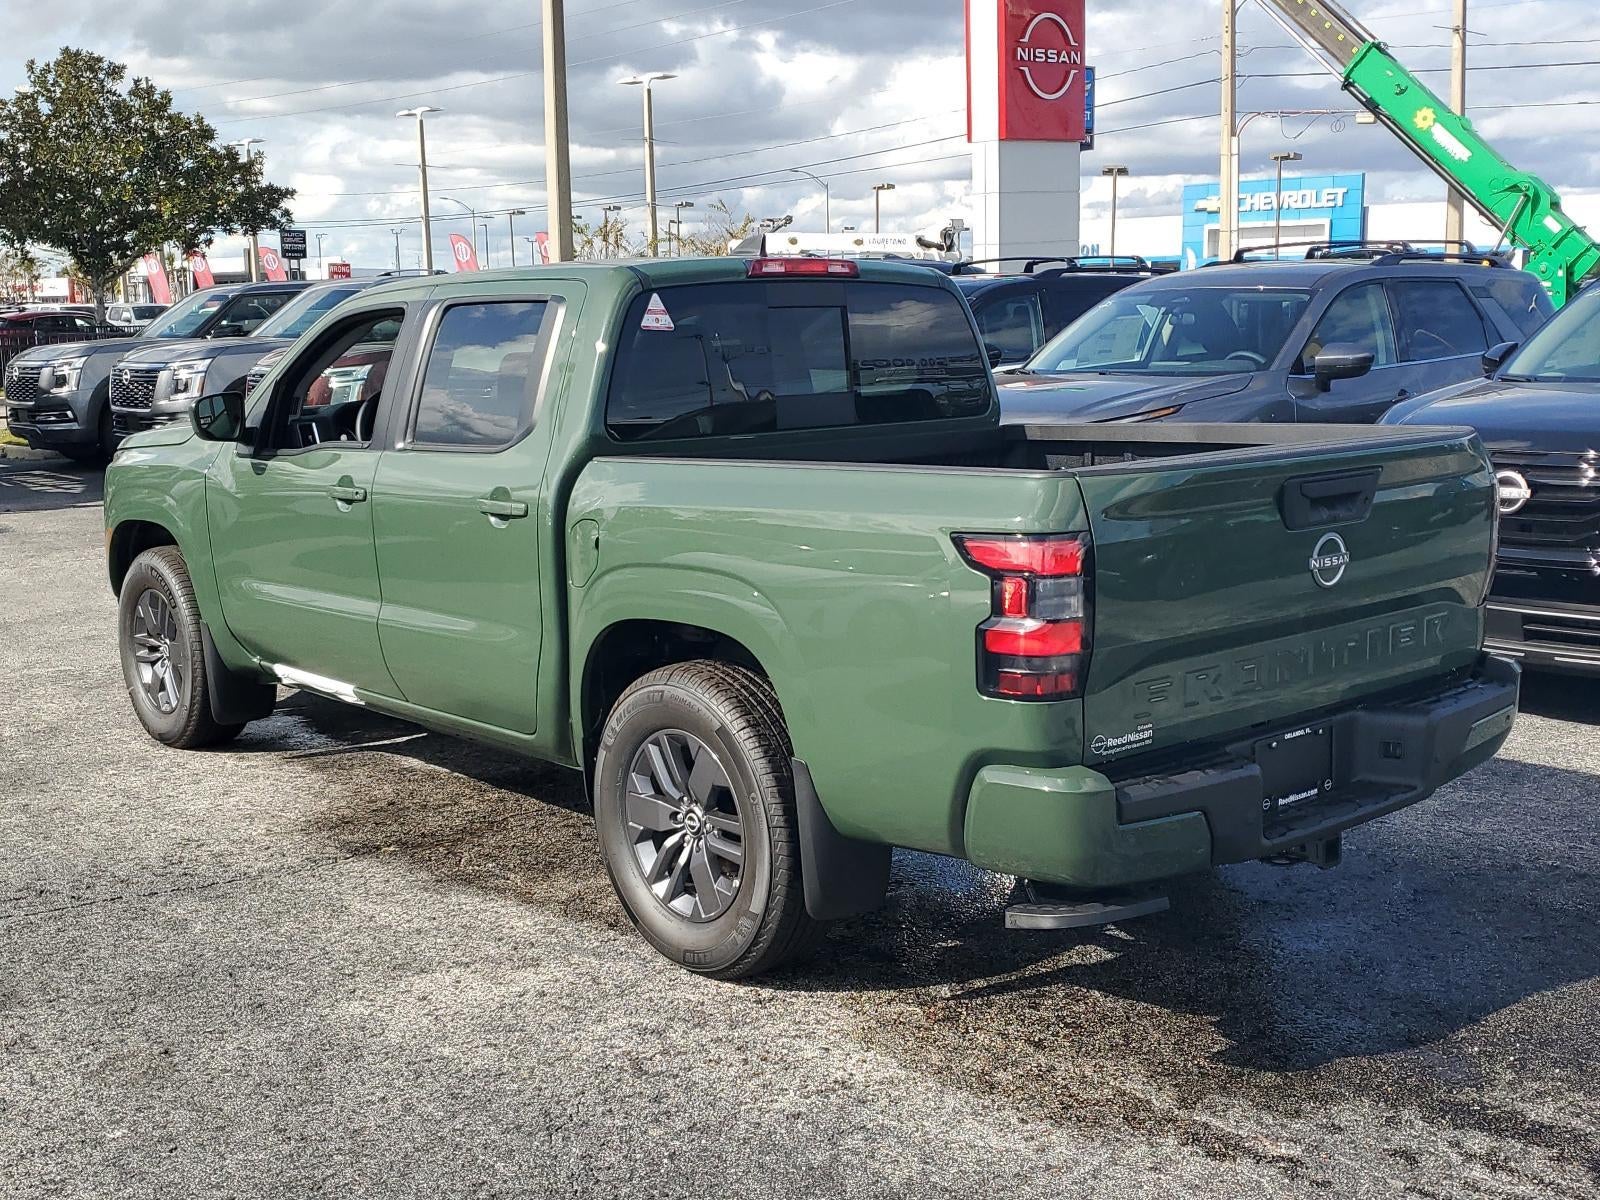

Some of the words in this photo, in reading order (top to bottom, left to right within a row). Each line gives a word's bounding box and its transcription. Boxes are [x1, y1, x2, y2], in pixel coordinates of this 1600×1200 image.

[1017, 47, 1081, 64] NISSAN
[1238, 187, 1348, 212] CHEVROLET
[1311, 553, 1350, 568] NISSAN
[1133, 611, 1449, 719] FRONTIER
